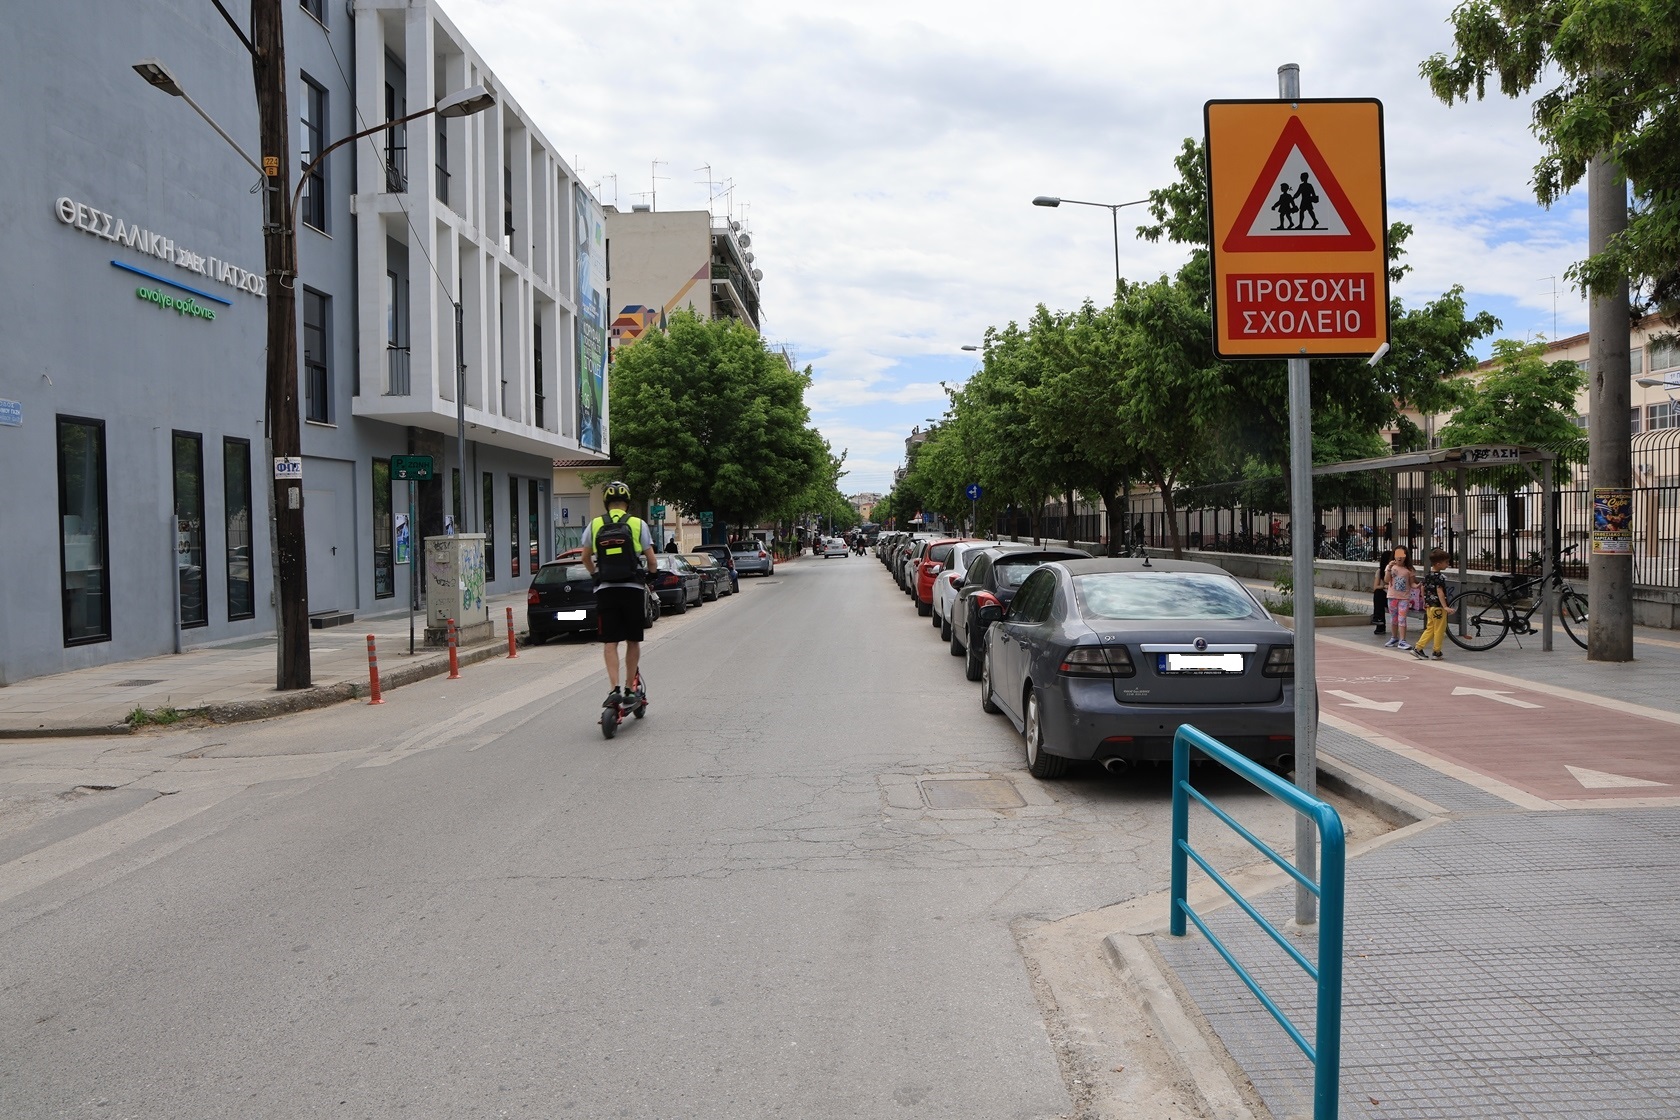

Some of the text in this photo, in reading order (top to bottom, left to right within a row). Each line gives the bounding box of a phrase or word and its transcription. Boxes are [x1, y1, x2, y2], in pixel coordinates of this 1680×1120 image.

[55, 196, 175, 262] ΘΕΣΣΑΛΙΚΗ
[206, 255, 266, 297] ΓΙΑΤΣΟΣ
[136, 286, 217, 320] ανοίγει ορίζοντες
[1236, 278, 1366, 303] ΠΡΟΣΟΧΗ
[1242, 309, 1361, 334] ΣΧΟΛΕΙΟ
